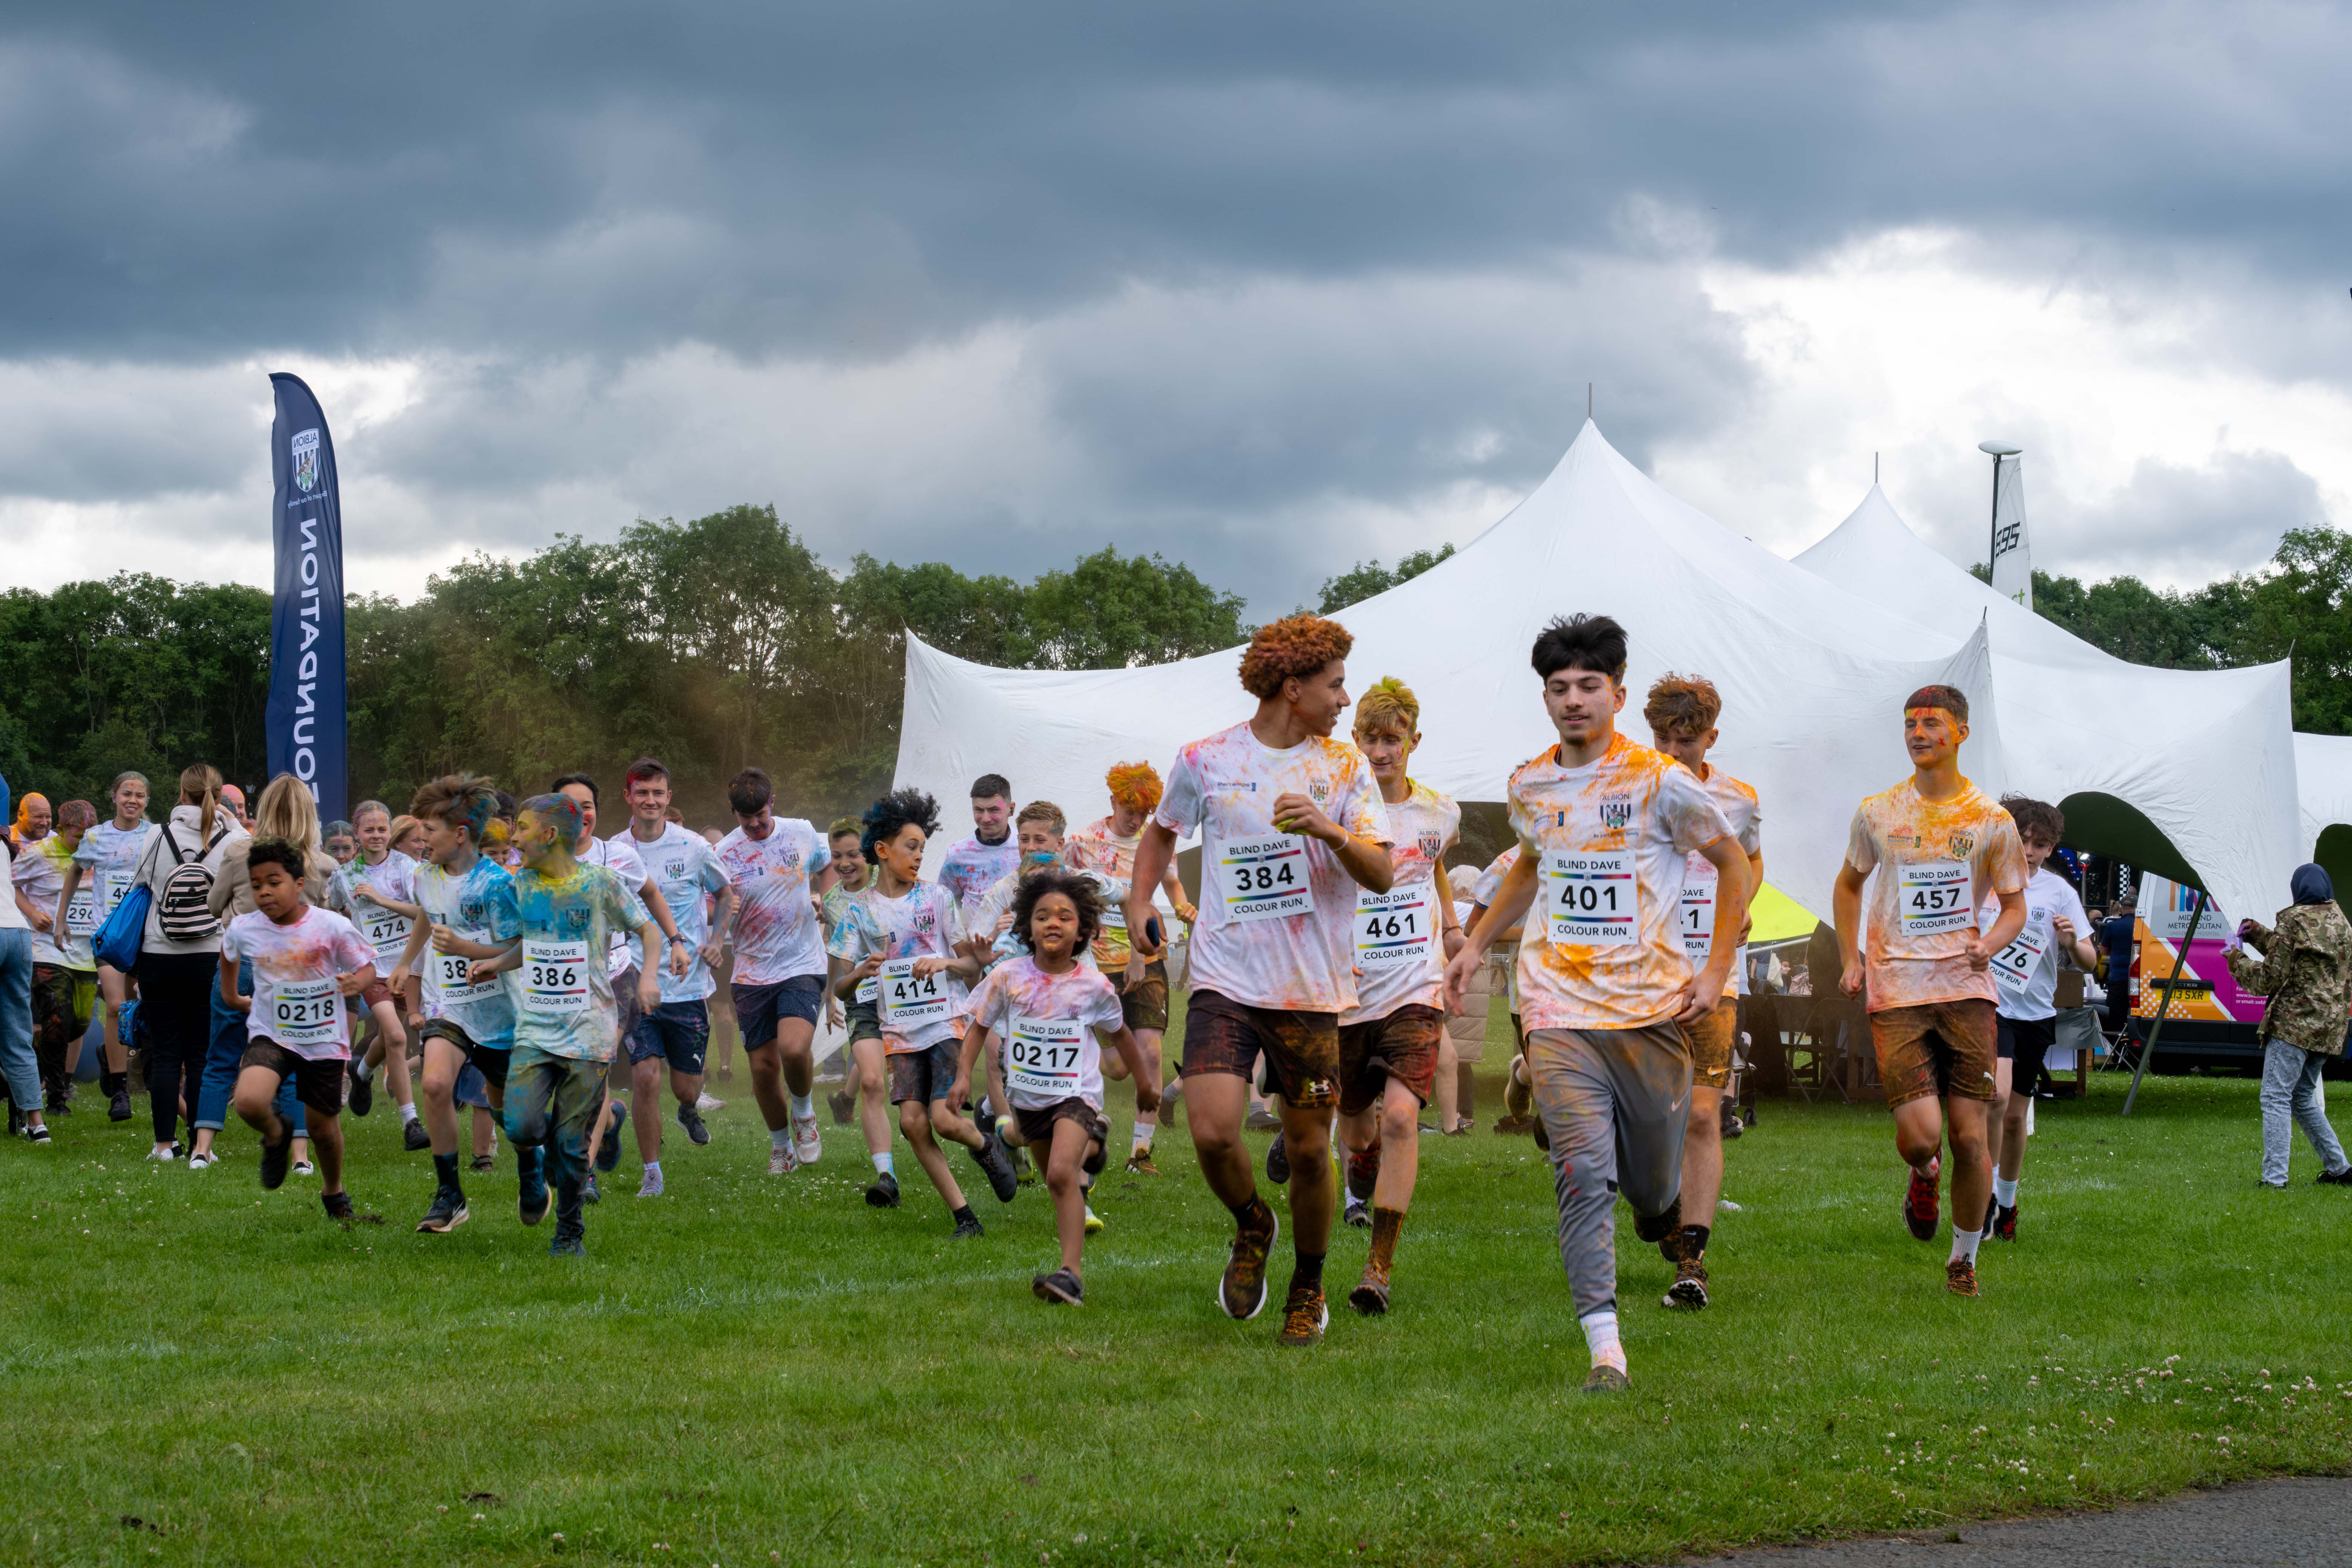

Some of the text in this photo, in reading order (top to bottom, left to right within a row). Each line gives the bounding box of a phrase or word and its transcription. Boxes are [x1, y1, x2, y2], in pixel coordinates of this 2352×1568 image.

[1229, 839, 1291, 855] BLIND DAVE
[1557, 859, 1621, 870] BLIND DAVE
[1235, 863, 1294, 891] 384
[1937, 870, 1960, 878] DAVE
[1362, 892, 1416, 905] BLIND DAVE
[1561, 885, 1616, 911] 401
[1913, 888, 1960, 910] 457
[1234, 897, 1303, 913] COLOUR RUN
[1366, 913, 1415, 938] 461
[1910, 916, 1966, 928] COLOUR RUN
[373, 920, 405, 939] 474
[1557, 925, 1627, 936] COLOUR RUN
[2019, 933, 2039, 946] DAVE
[377, 944, 398, 952] OLOUR
[531, 947, 551, 956] BLIND
[1364, 946, 1424, 959] COLOUR RUN
[2001, 945, 2028, 968] 76
[444, 959, 467, 979] 38
[1990, 966, 2021, 985] OUR RUN
[532, 966, 576, 986] 386
[310, 984, 329, 992] DAVE
[446, 983, 495, 997] COLOUR RUN
[862, 988, 878, 996] COLO
[894, 978, 937, 999] 414
[530, 996, 561, 1005] COLOUR
[2185, 990, 2204, 1000] SXR
[278, 999, 334, 1021] 0218
[894, 1008, 925, 1017] COLOUR
[1020, 1023, 1045, 1034] BLIND
[1013, 1042, 1079, 1067] 0217
[1015, 1074, 1049, 1087] COLOUR
